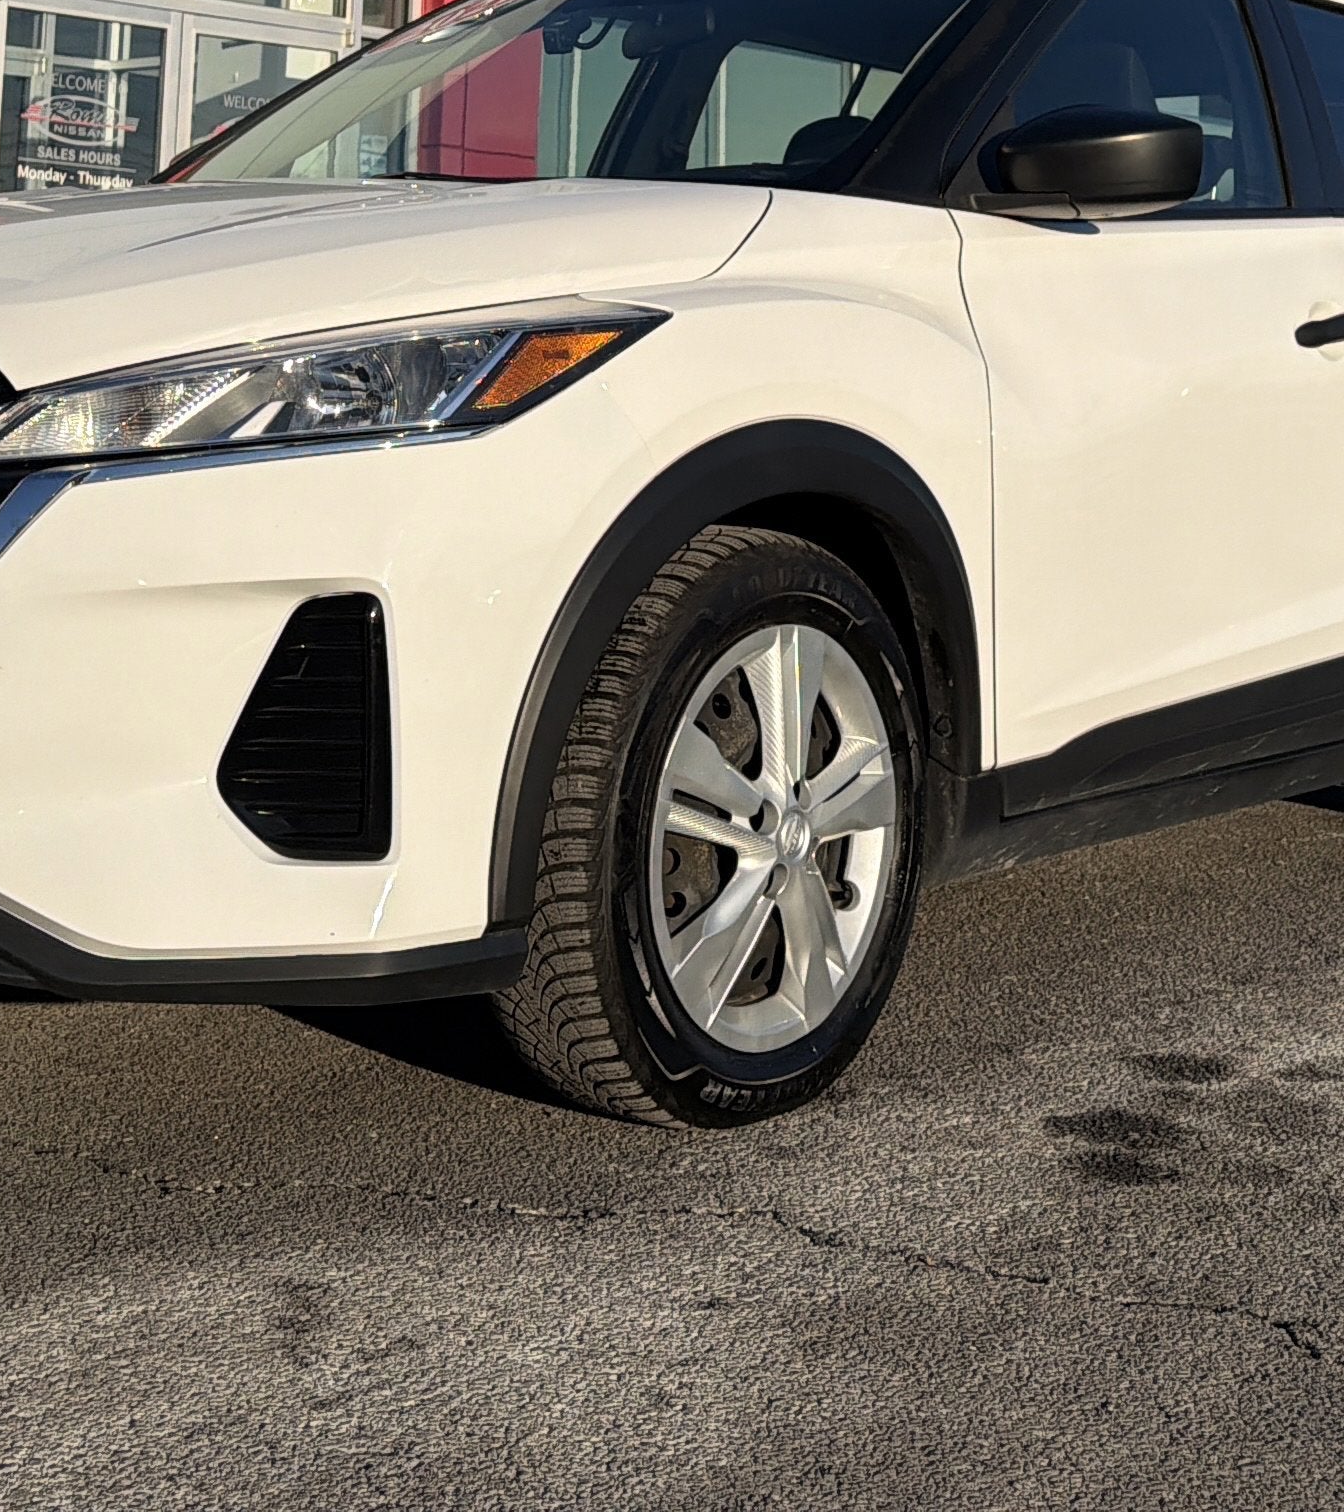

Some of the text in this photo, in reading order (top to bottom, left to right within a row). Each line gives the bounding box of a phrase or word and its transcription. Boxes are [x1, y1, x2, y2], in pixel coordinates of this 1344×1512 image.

[44, 72, 106, 93] ELCOME
[223, 93, 271, 112] WELCO
[37, 145, 121, 167] SALES HOURS
[17, 164, 67, 185] Monday
[77, 170, 134, 189] Thursday
